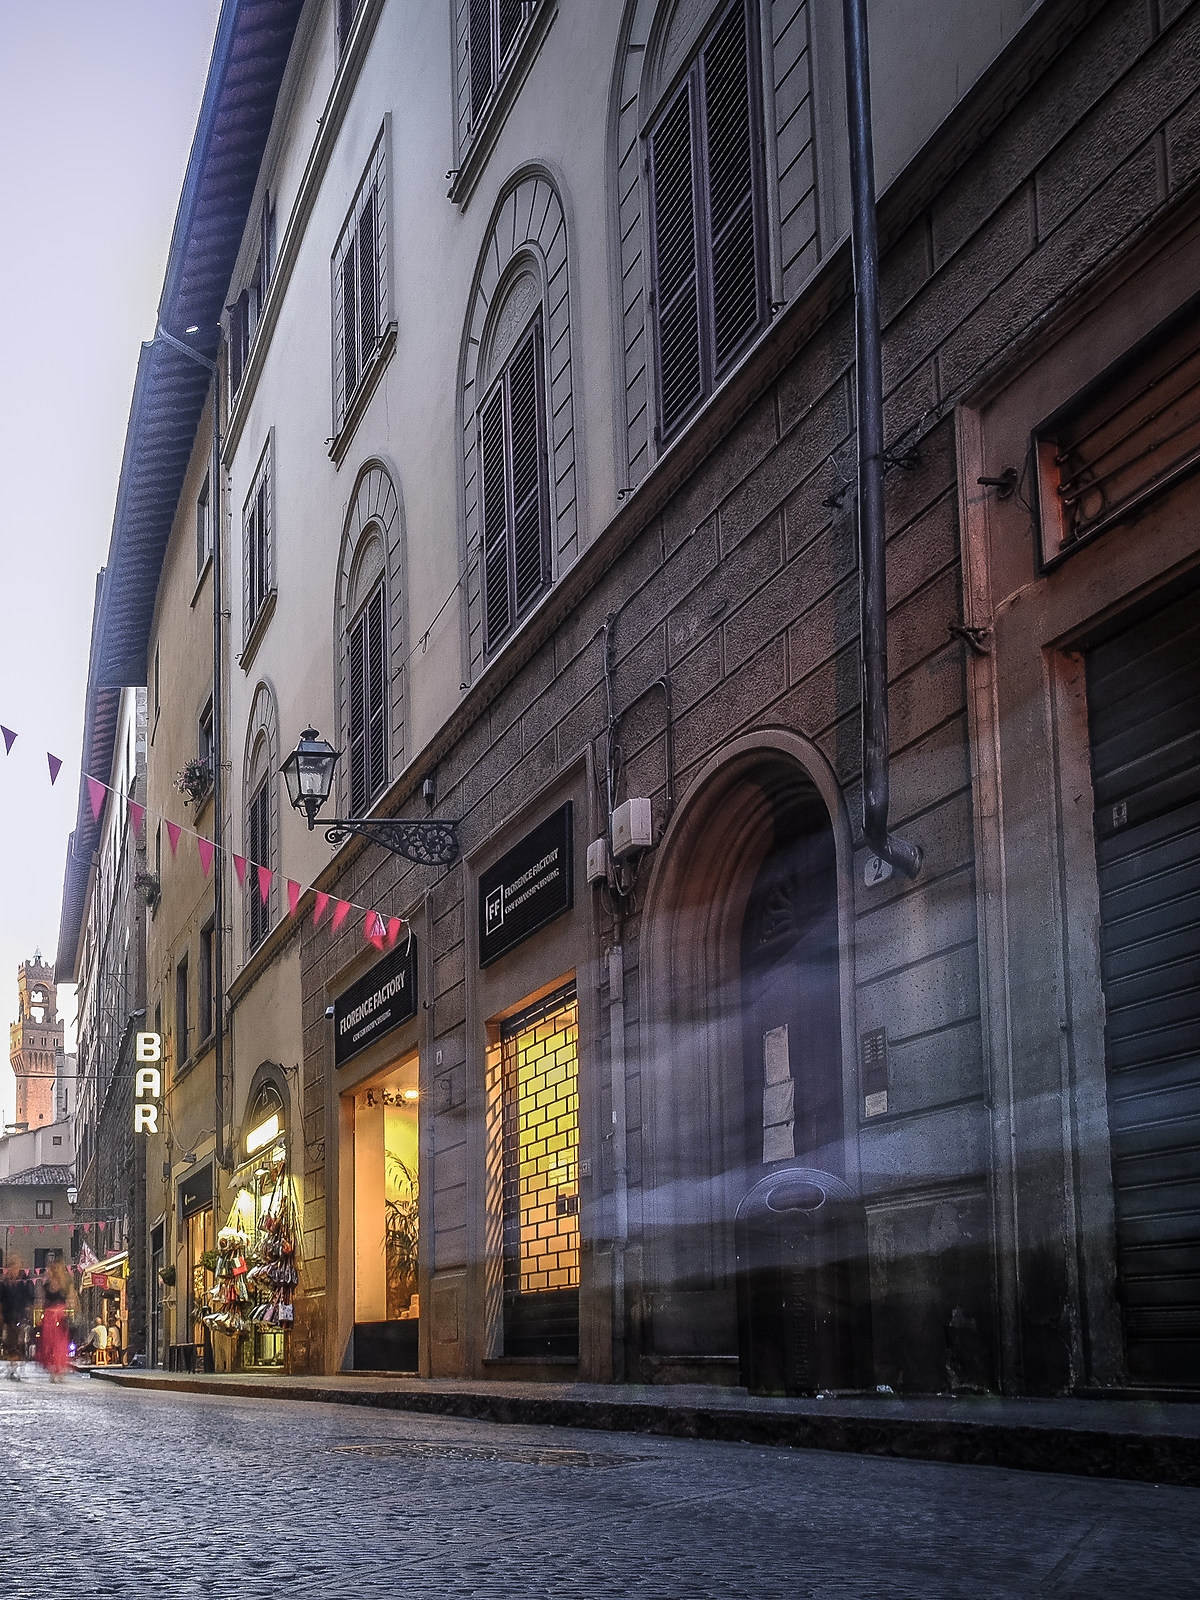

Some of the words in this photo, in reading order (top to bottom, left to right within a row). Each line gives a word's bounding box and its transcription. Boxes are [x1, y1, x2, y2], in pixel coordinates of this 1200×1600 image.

[504, 868, 534, 899] FLORENCE
[533, 847, 559, 877] FACTORY
[489, 898, 500, 921] FF
[339, 996, 374, 1036] FLORENCE
[373, 969, 406, 1011] FACTORY
[134, 1031, 161, 1133] BAR
